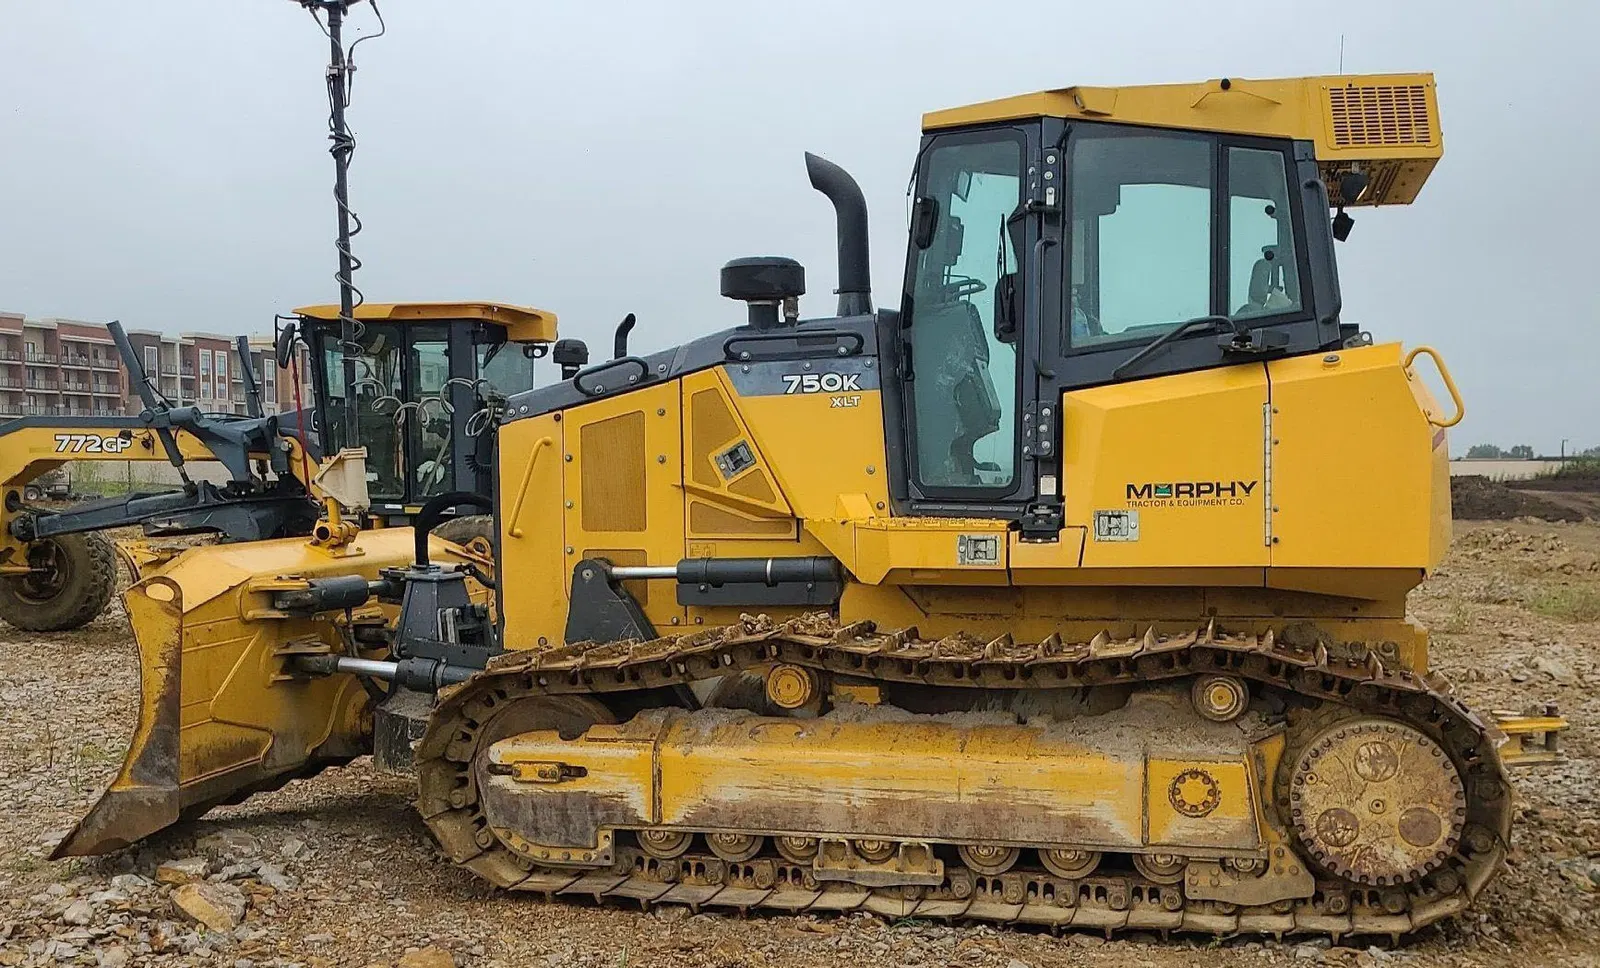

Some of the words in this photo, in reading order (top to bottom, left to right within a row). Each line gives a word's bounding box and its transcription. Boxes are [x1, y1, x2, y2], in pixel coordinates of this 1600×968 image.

[782, 373, 863, 395] 750K
[830, 395, 861, 408] XLT
[54, 433, 132, 453] 772GP
[1127, 500, 1166, 508] TRACTOR
[1168, 499, 1175, 507] &
[1177, 498, 1227, 507] EQUIPMENT
[1229, 498, 1245, 506] CO.
